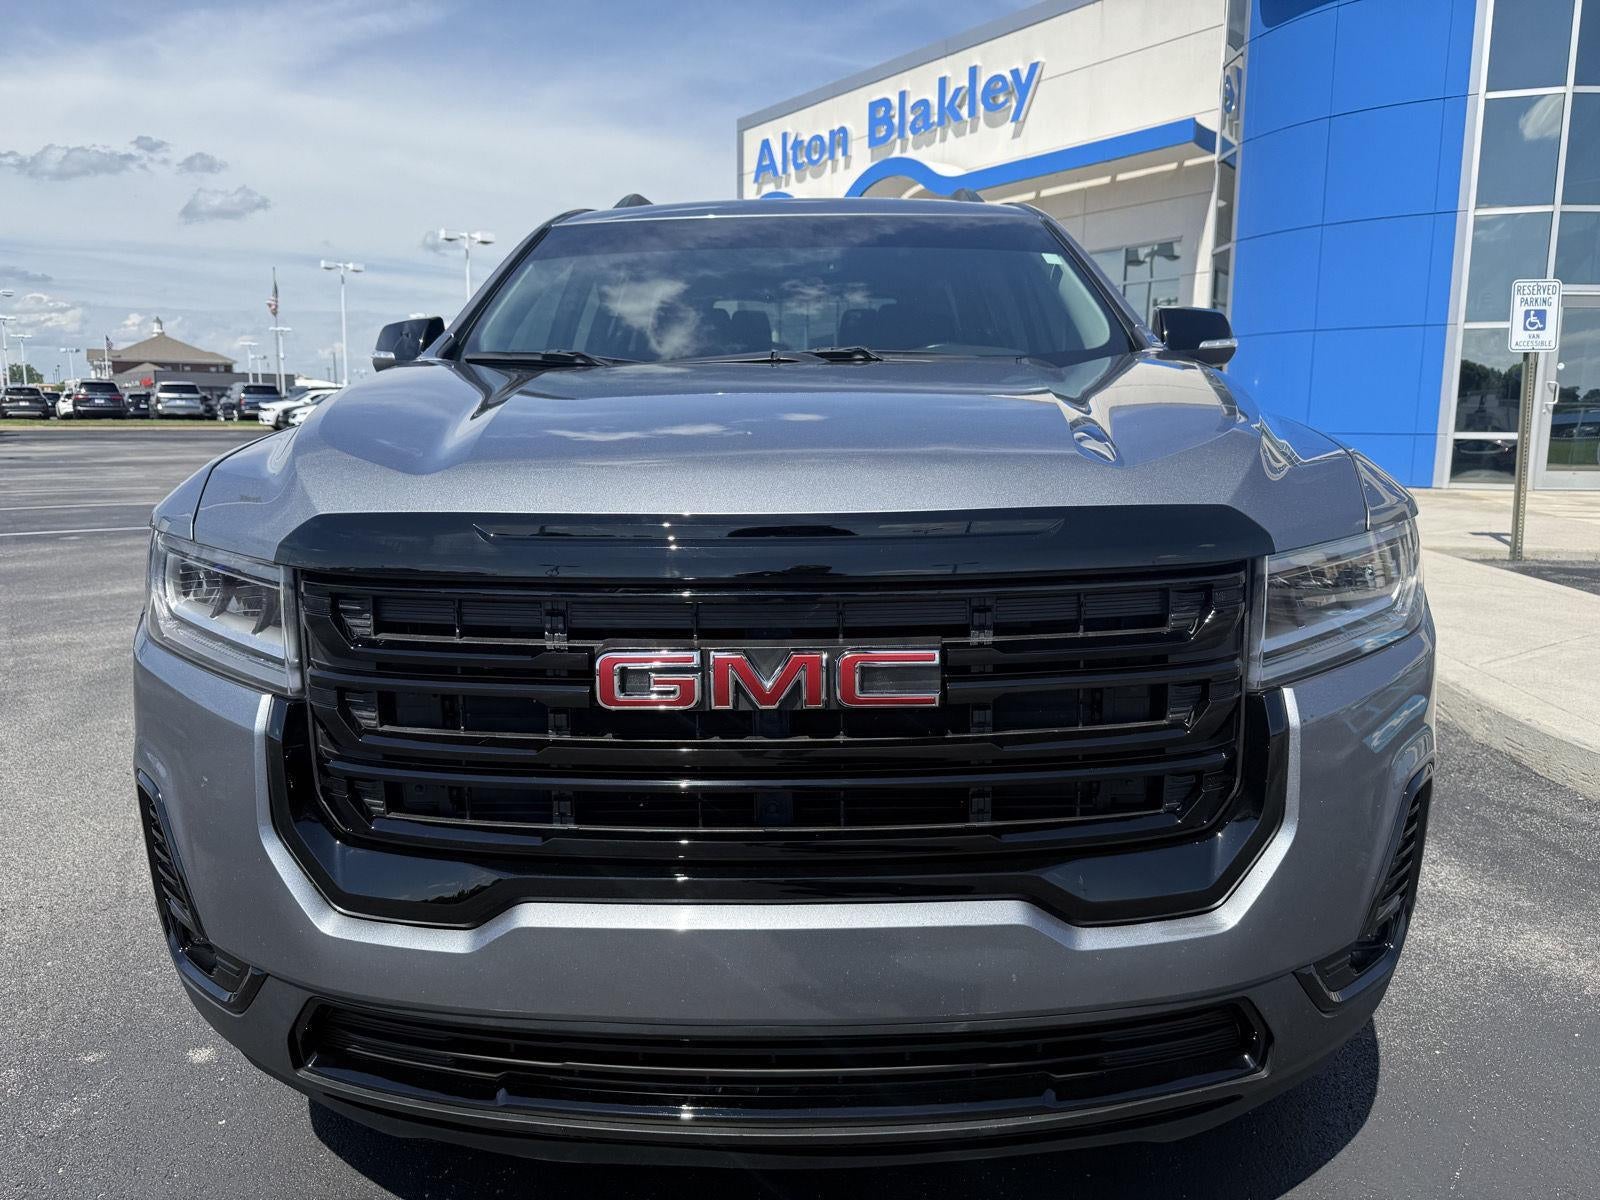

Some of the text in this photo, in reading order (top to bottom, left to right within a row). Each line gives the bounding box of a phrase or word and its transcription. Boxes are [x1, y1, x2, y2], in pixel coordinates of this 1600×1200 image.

[753, 60, 1042, 185] Alton Blakley
[1516, 284, 1557, 296] RESERVED
[1520, 296, 1552, 307] PARKING
[595, 648, 941, 711] GMC
